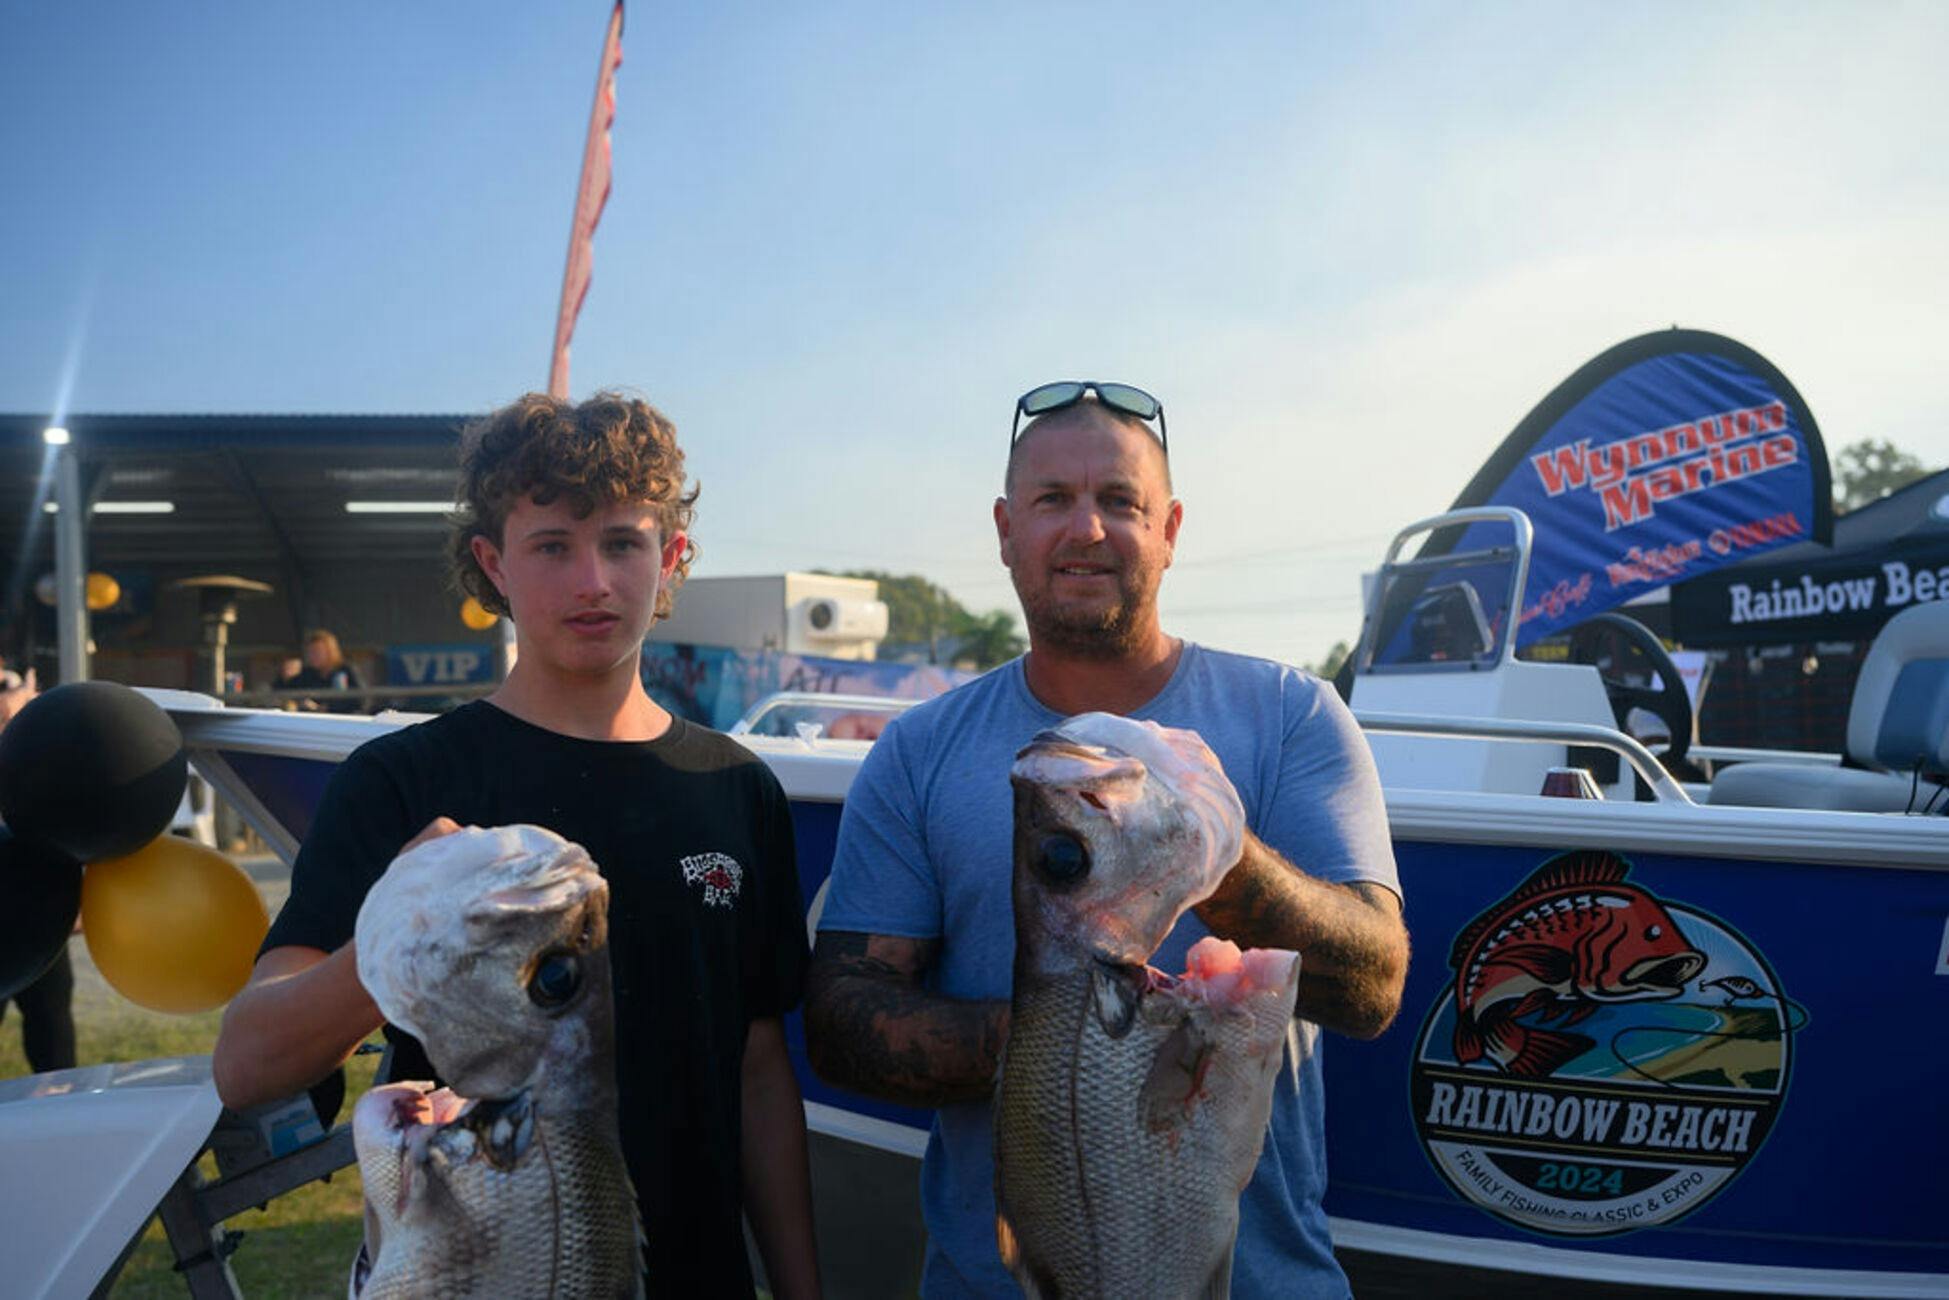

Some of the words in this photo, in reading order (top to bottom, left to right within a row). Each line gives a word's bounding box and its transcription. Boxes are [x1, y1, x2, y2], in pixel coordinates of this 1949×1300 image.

[1531, 399, 1787, 497] Wynnum
[1600, 434, 1798, 533] Marine
[1729, 574, 1876, 624] Rainbow
[401, 652, 479, 682] VIP
[1425, 1082, 1623, 1143] RAINBOW
[1620, 1101, 1757, 1152] BEACH
[1456, 1150, 1503, 1196] FAMILY
[1646, 1198, 1660, 1212] &
[1663, 1171, 1704, 1205] EXPO
[1536, 1164, 1624, 1195] 2024
